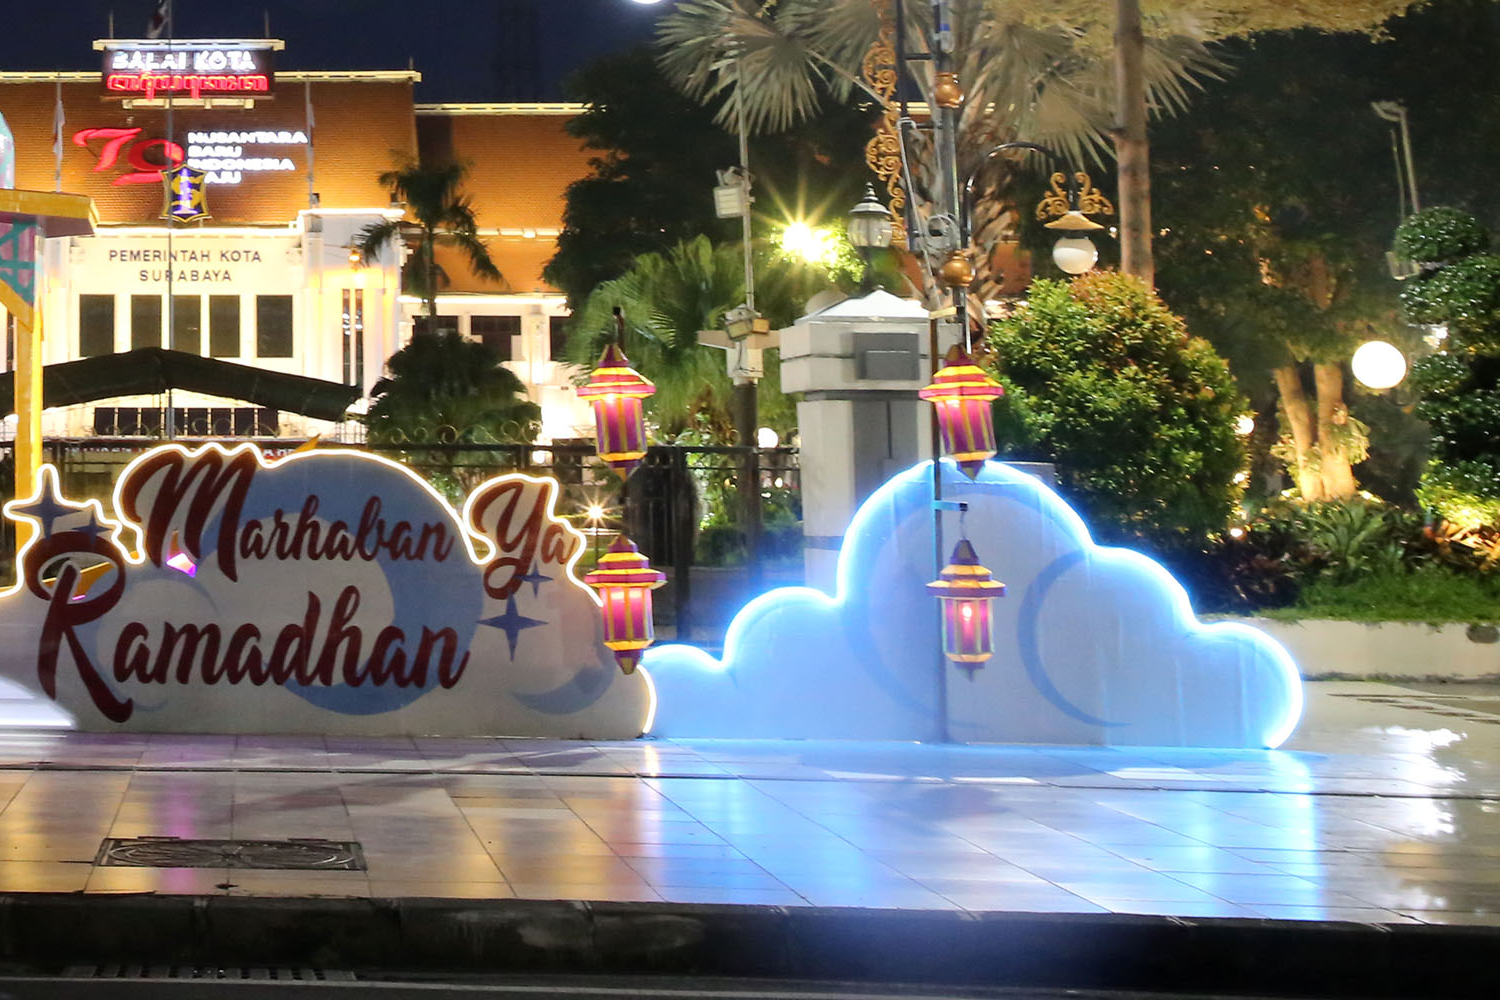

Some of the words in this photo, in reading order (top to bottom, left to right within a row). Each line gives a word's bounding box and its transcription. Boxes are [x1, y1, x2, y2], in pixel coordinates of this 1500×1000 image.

[112, 51, 187, 70] BALAI
[193, 50, 256, 71] KOTA
[187, 131, 308, 144] NUSANTARA
[203, 171, 242, 183] AJU
[109, 250, 210, 262] PEMERINTAH
[219, 250, 262, 262] KOTA
[139, 270, 232, 281] SURABAYA
[121, 450, 456, 583] Marhaban
[471, 481, 577, 598] Ya
[24, 530, 470, 724] Ramadhan
